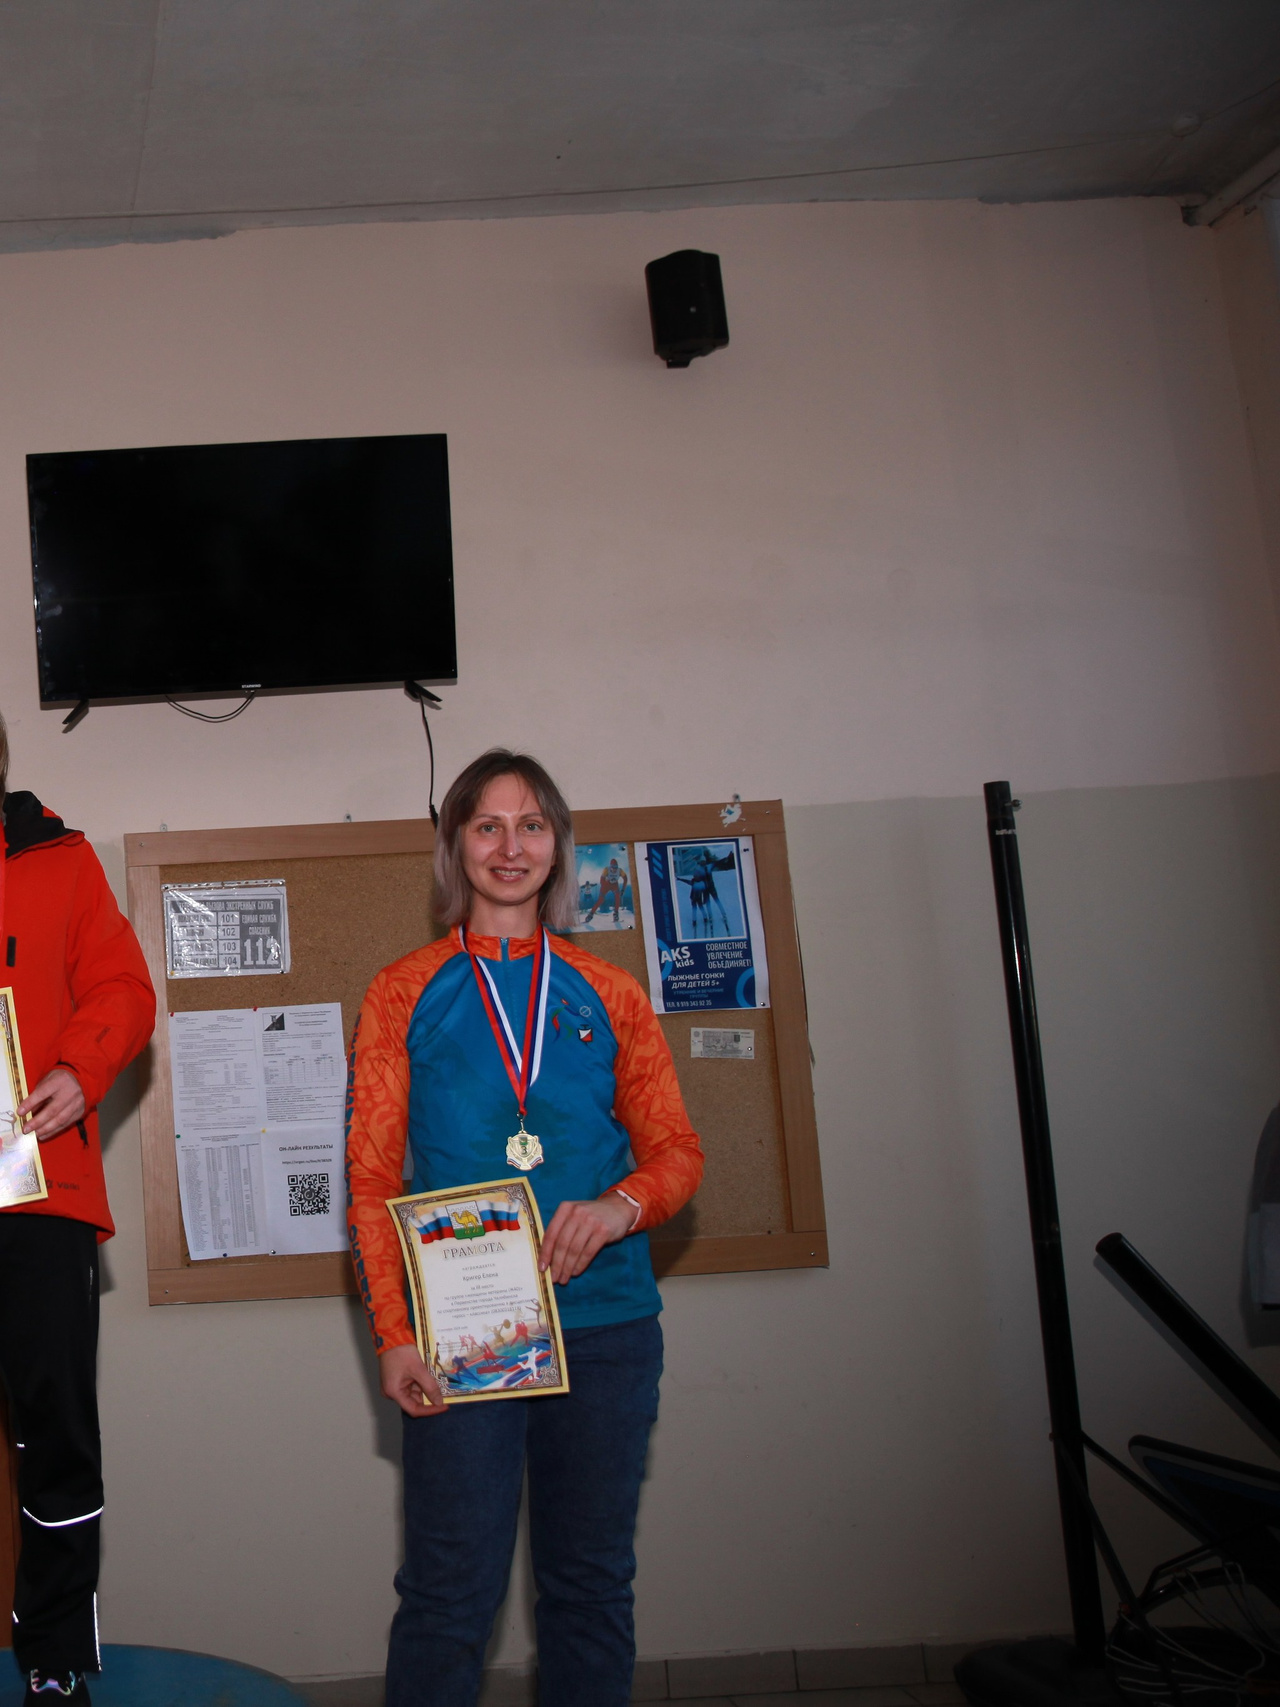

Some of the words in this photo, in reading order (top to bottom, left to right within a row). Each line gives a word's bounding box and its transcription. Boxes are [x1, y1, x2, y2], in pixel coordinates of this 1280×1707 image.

[222, 914, 234, 922] 101
[222, 928, 236, 936] 102
[223, 942, 236, 951] 103
[706, 942, 747, 951] СОВМЕСТНОЕ
[244, 938, 279, 966] 112
[661, 946, 690, 963] AKS
[707, 950, 743, 961] УВЛЕЧЕНИЕ
[224, 956, 237, 966] 104
[676, 959, 694, 968] kids
[708, 959, 751, 969] ОБЪЕДИНЯЕТ!
[668, 973, 699, 981] ЛЫЖНЫЕ
[687, 980, 710, 988] ДЕТЕЙ
[521, 1146, 528, 1155] 3
[442, 1242, 504, 1259] ГРАМОТА
